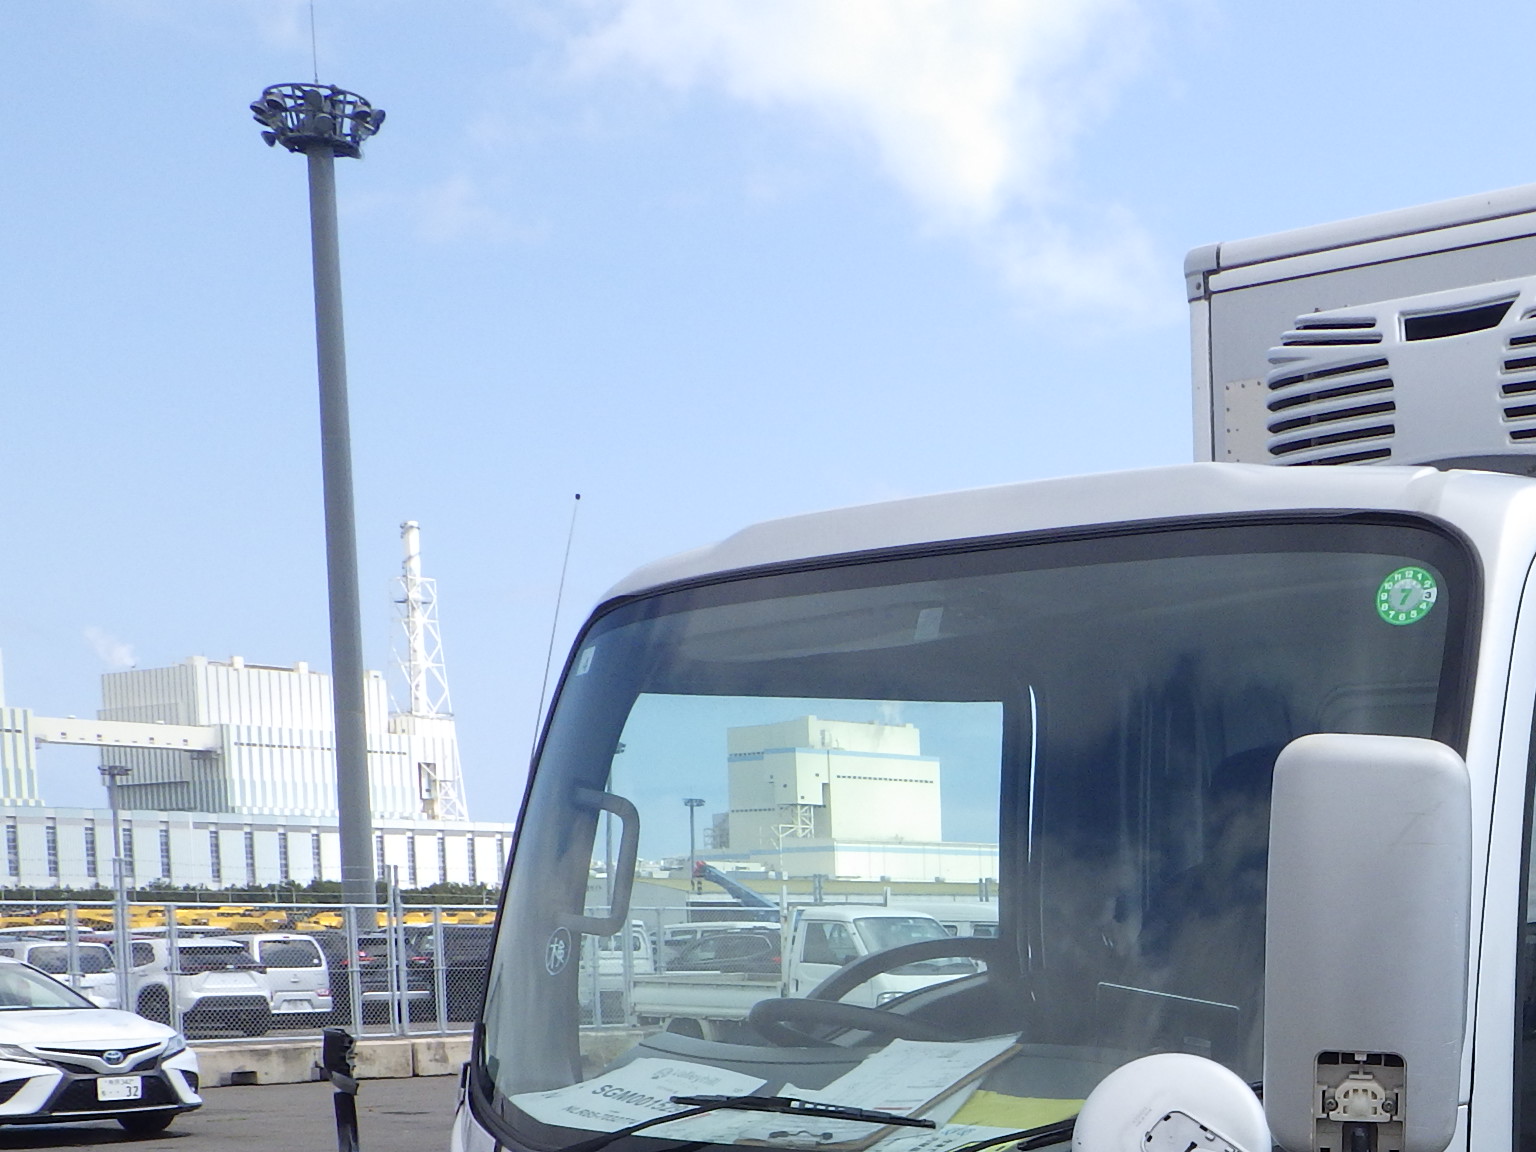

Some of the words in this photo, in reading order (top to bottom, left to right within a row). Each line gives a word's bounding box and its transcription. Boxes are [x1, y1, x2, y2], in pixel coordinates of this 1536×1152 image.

[1380, 592, 1388, 600] 9
[1400, 588, 1413, 605] 7
[1424, 591, 1431, 599] 3
[1381, 602, 1389, 611] 8
[1389, 610, 1395, 618] 7
[1398, 612, 1406, 620] 6
[126, 1085, 139, 1097] 32
